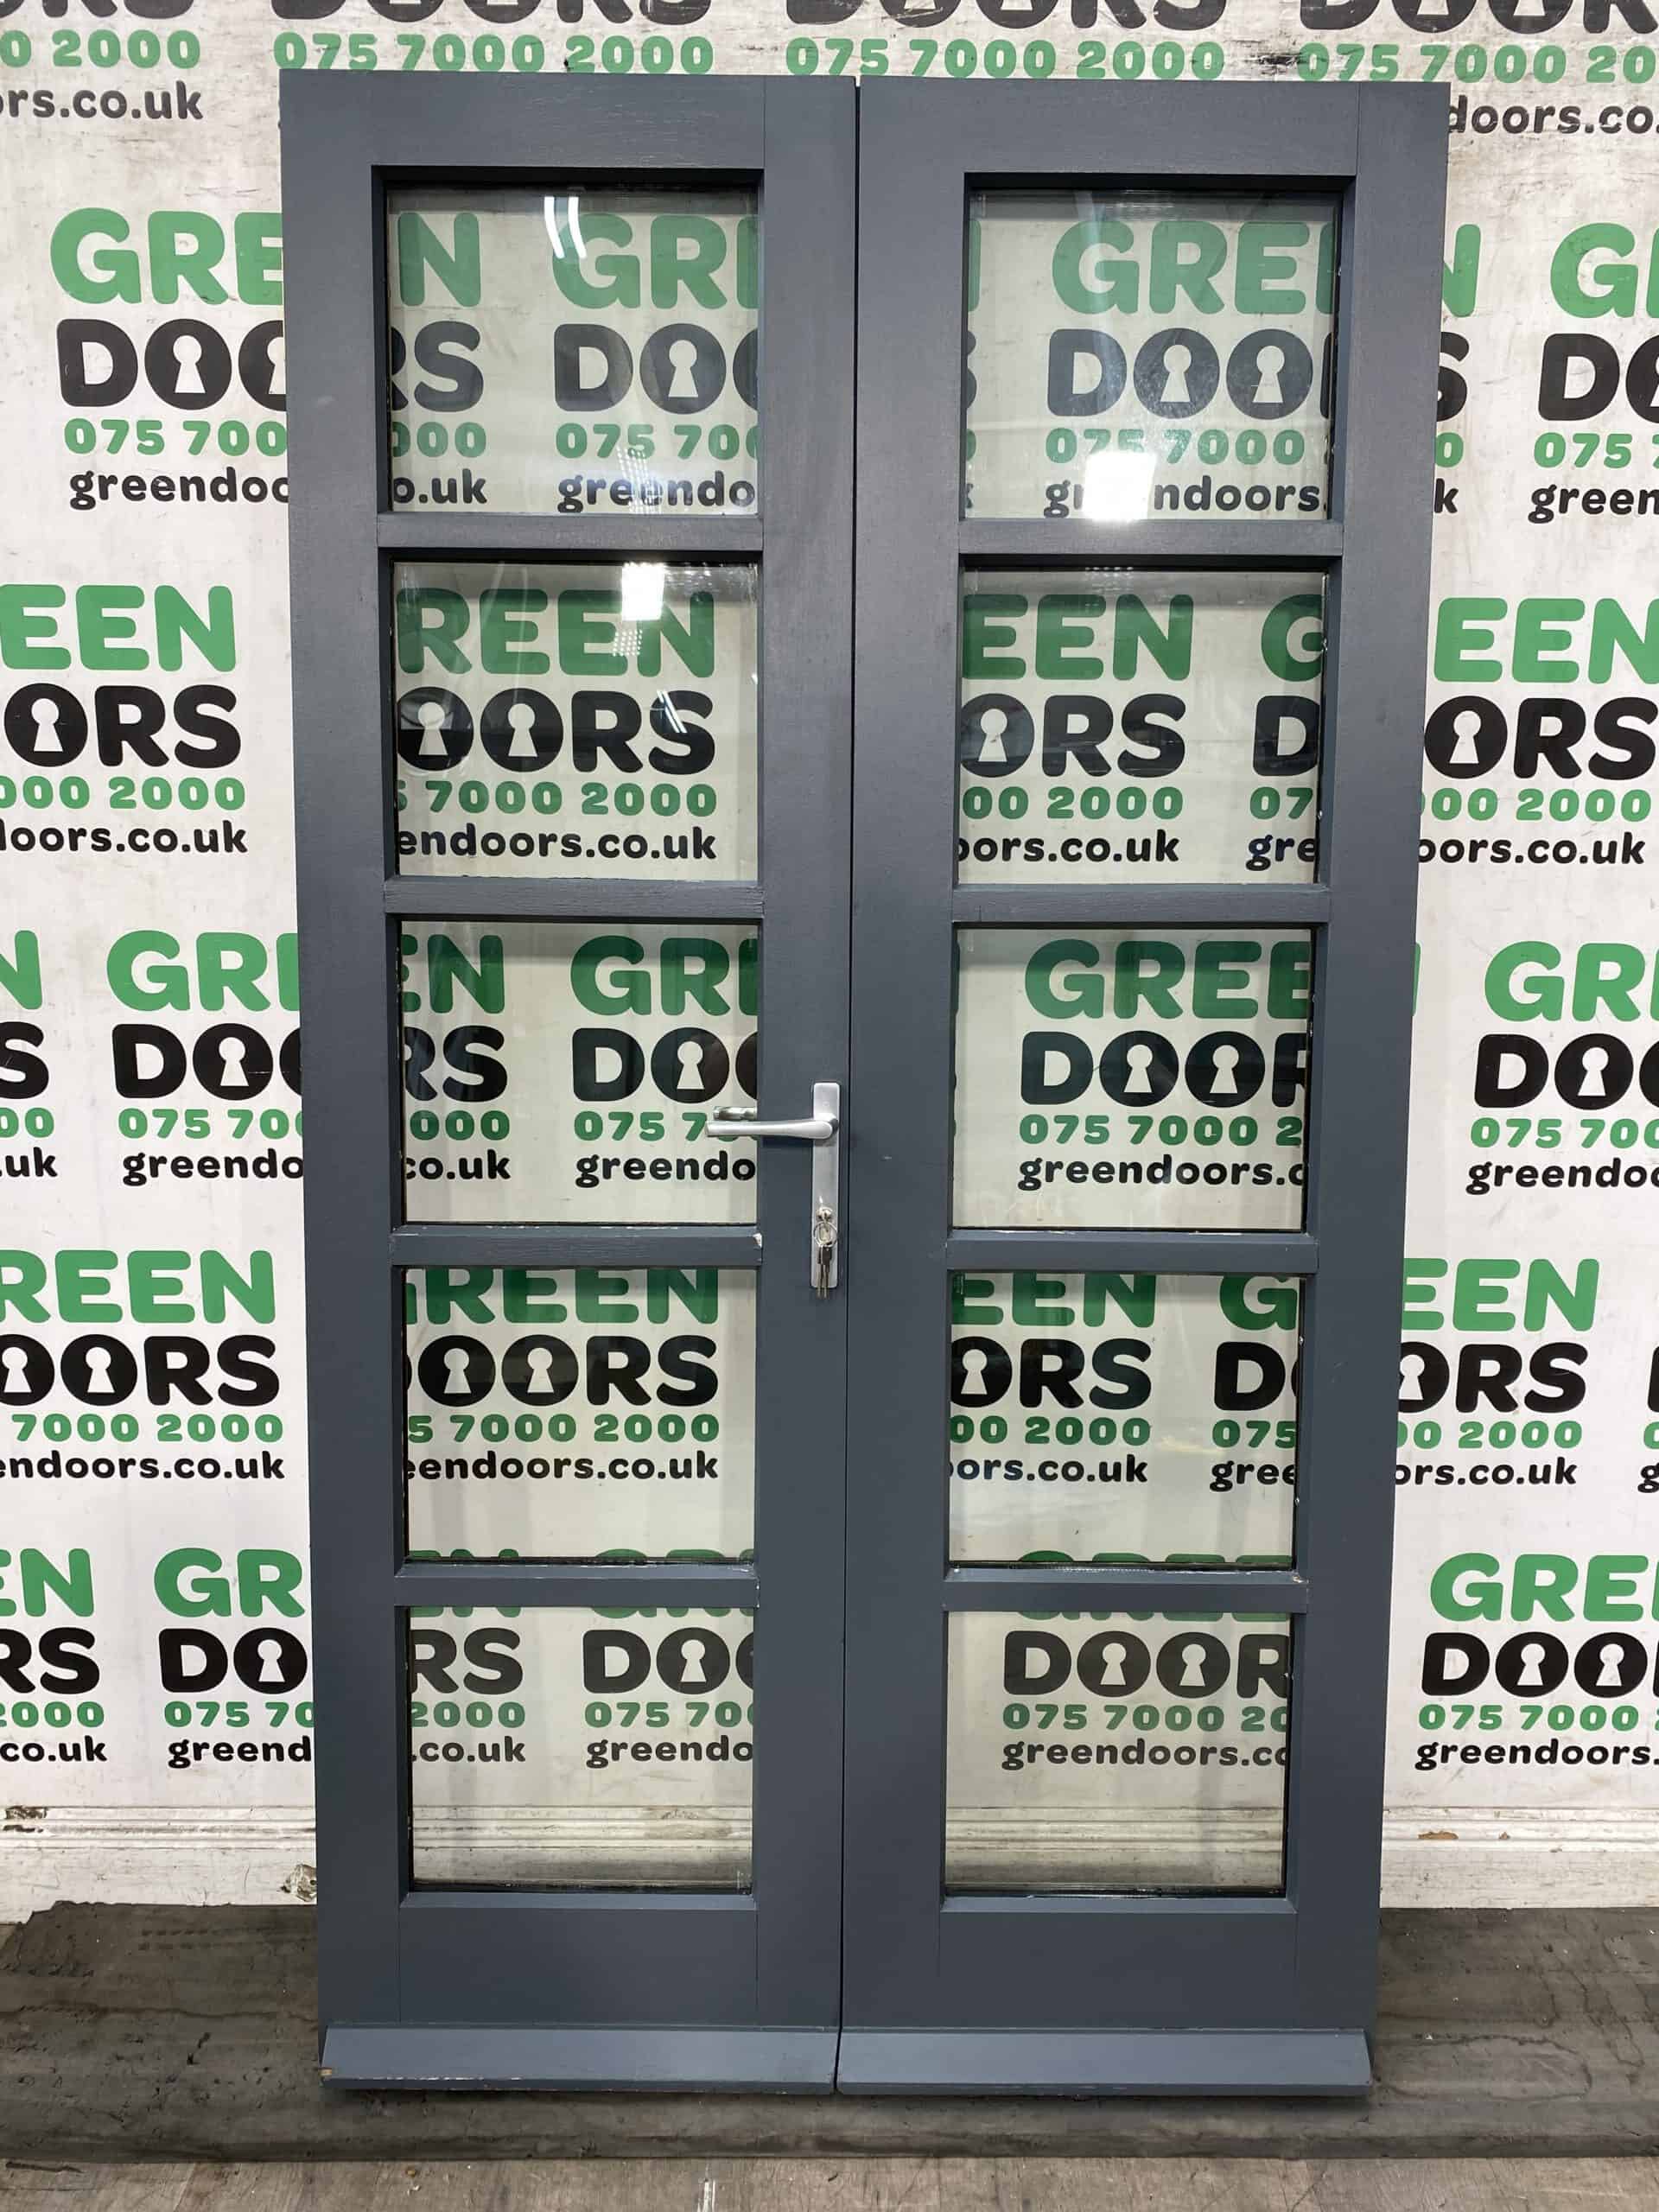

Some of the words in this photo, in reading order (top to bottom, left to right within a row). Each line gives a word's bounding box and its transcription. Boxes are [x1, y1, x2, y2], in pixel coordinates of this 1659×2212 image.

[52, 30, 202, 69] 2000
[273, 33, 377, 70] 075
[397, 34, 544, 71] 7000
[566, 35, 714, 74] 2000
[786, 38, 889, 75] 075
[910, 39, 1056, 79] 7000
[1076, 40, 1225, 79] 2000
[1298, 43, 1400, 81] 075
[1421, 45, 1567, 83] 7000
[551, 214, 757, 308] GR
[1052, 220, 1335, 315] GRE
[554, 323, 757, 411] DO
[1046, 327, 1336, 420] DOO
[64, 418, 164, 455] 075
[556, 423, 657, 459] 075
[1159, 429, 1306, 465] 7000
[1534, 433, 1631, 468] 075
[109, 776, 245, 810] 2000
[426, 781, 562, 816] 7000
[582, 782, 717, 817] 2000
[1047, 786, 1183, 819] 2000
[1421, 787, 1496, 821] 00
[1516, 787, 1650, 821] 2000
[959, 830, 1179, 862] oors.co.uk
[570, 935, 759, 1018] GR
[1484, 941, 1659, 1022] GR
[112, 1021, 302, 1101] DO
[572, 1027, 759, 1103] DO
[1473, 1033, 1659, 1109] DO
[118, 1108, 211, 1139] 075
[226, 1109, 302, 1140] 70
[574, 1109, 665, 1141] 075
[1019, 1116, 1109, 1144] 075
[1127, 1116, 1258, 1146] 7000
[1470, 1118, 1562, 1148] 075
[405, 1268, 719, 1324] REEN
[406, 1335, 719, 1406] OORS
[1214, 1343, 1298, 1412] D
[12, 1414, 139, 1441] 7000
[157, 1414, 283, 1441] 2000
[450, 1414, 577, 1443] 7000
[594, 1414, 719, 1443] 2000
[1025, 1416, 1150, 1444] 2000
[1459, 1421, 1583, 1448] 2000
[0, 1451, 285, 1479] ndoors.co.uk
[950, 1455, 1147, 1484] ors.co.uk
[1429, 1553, 1659, 1621] GRE
[583, 1630, 753, 1694] DO
[1421, 1632, 1659, 1697] DOO
[0, 1702, 104, 1727] 000
[163, 1702, 250, 1727] 075
[584, 1702, 669, 1728] 075
[687, 1702, 755, 1728] 70
[1003, 1703, 1087, 1731] 075
[1103, 1703, 1225, 1732] 7000
[1419, 1705, 1502, 1731] 075
[1518, 1705, 1638, 1732] 7000
